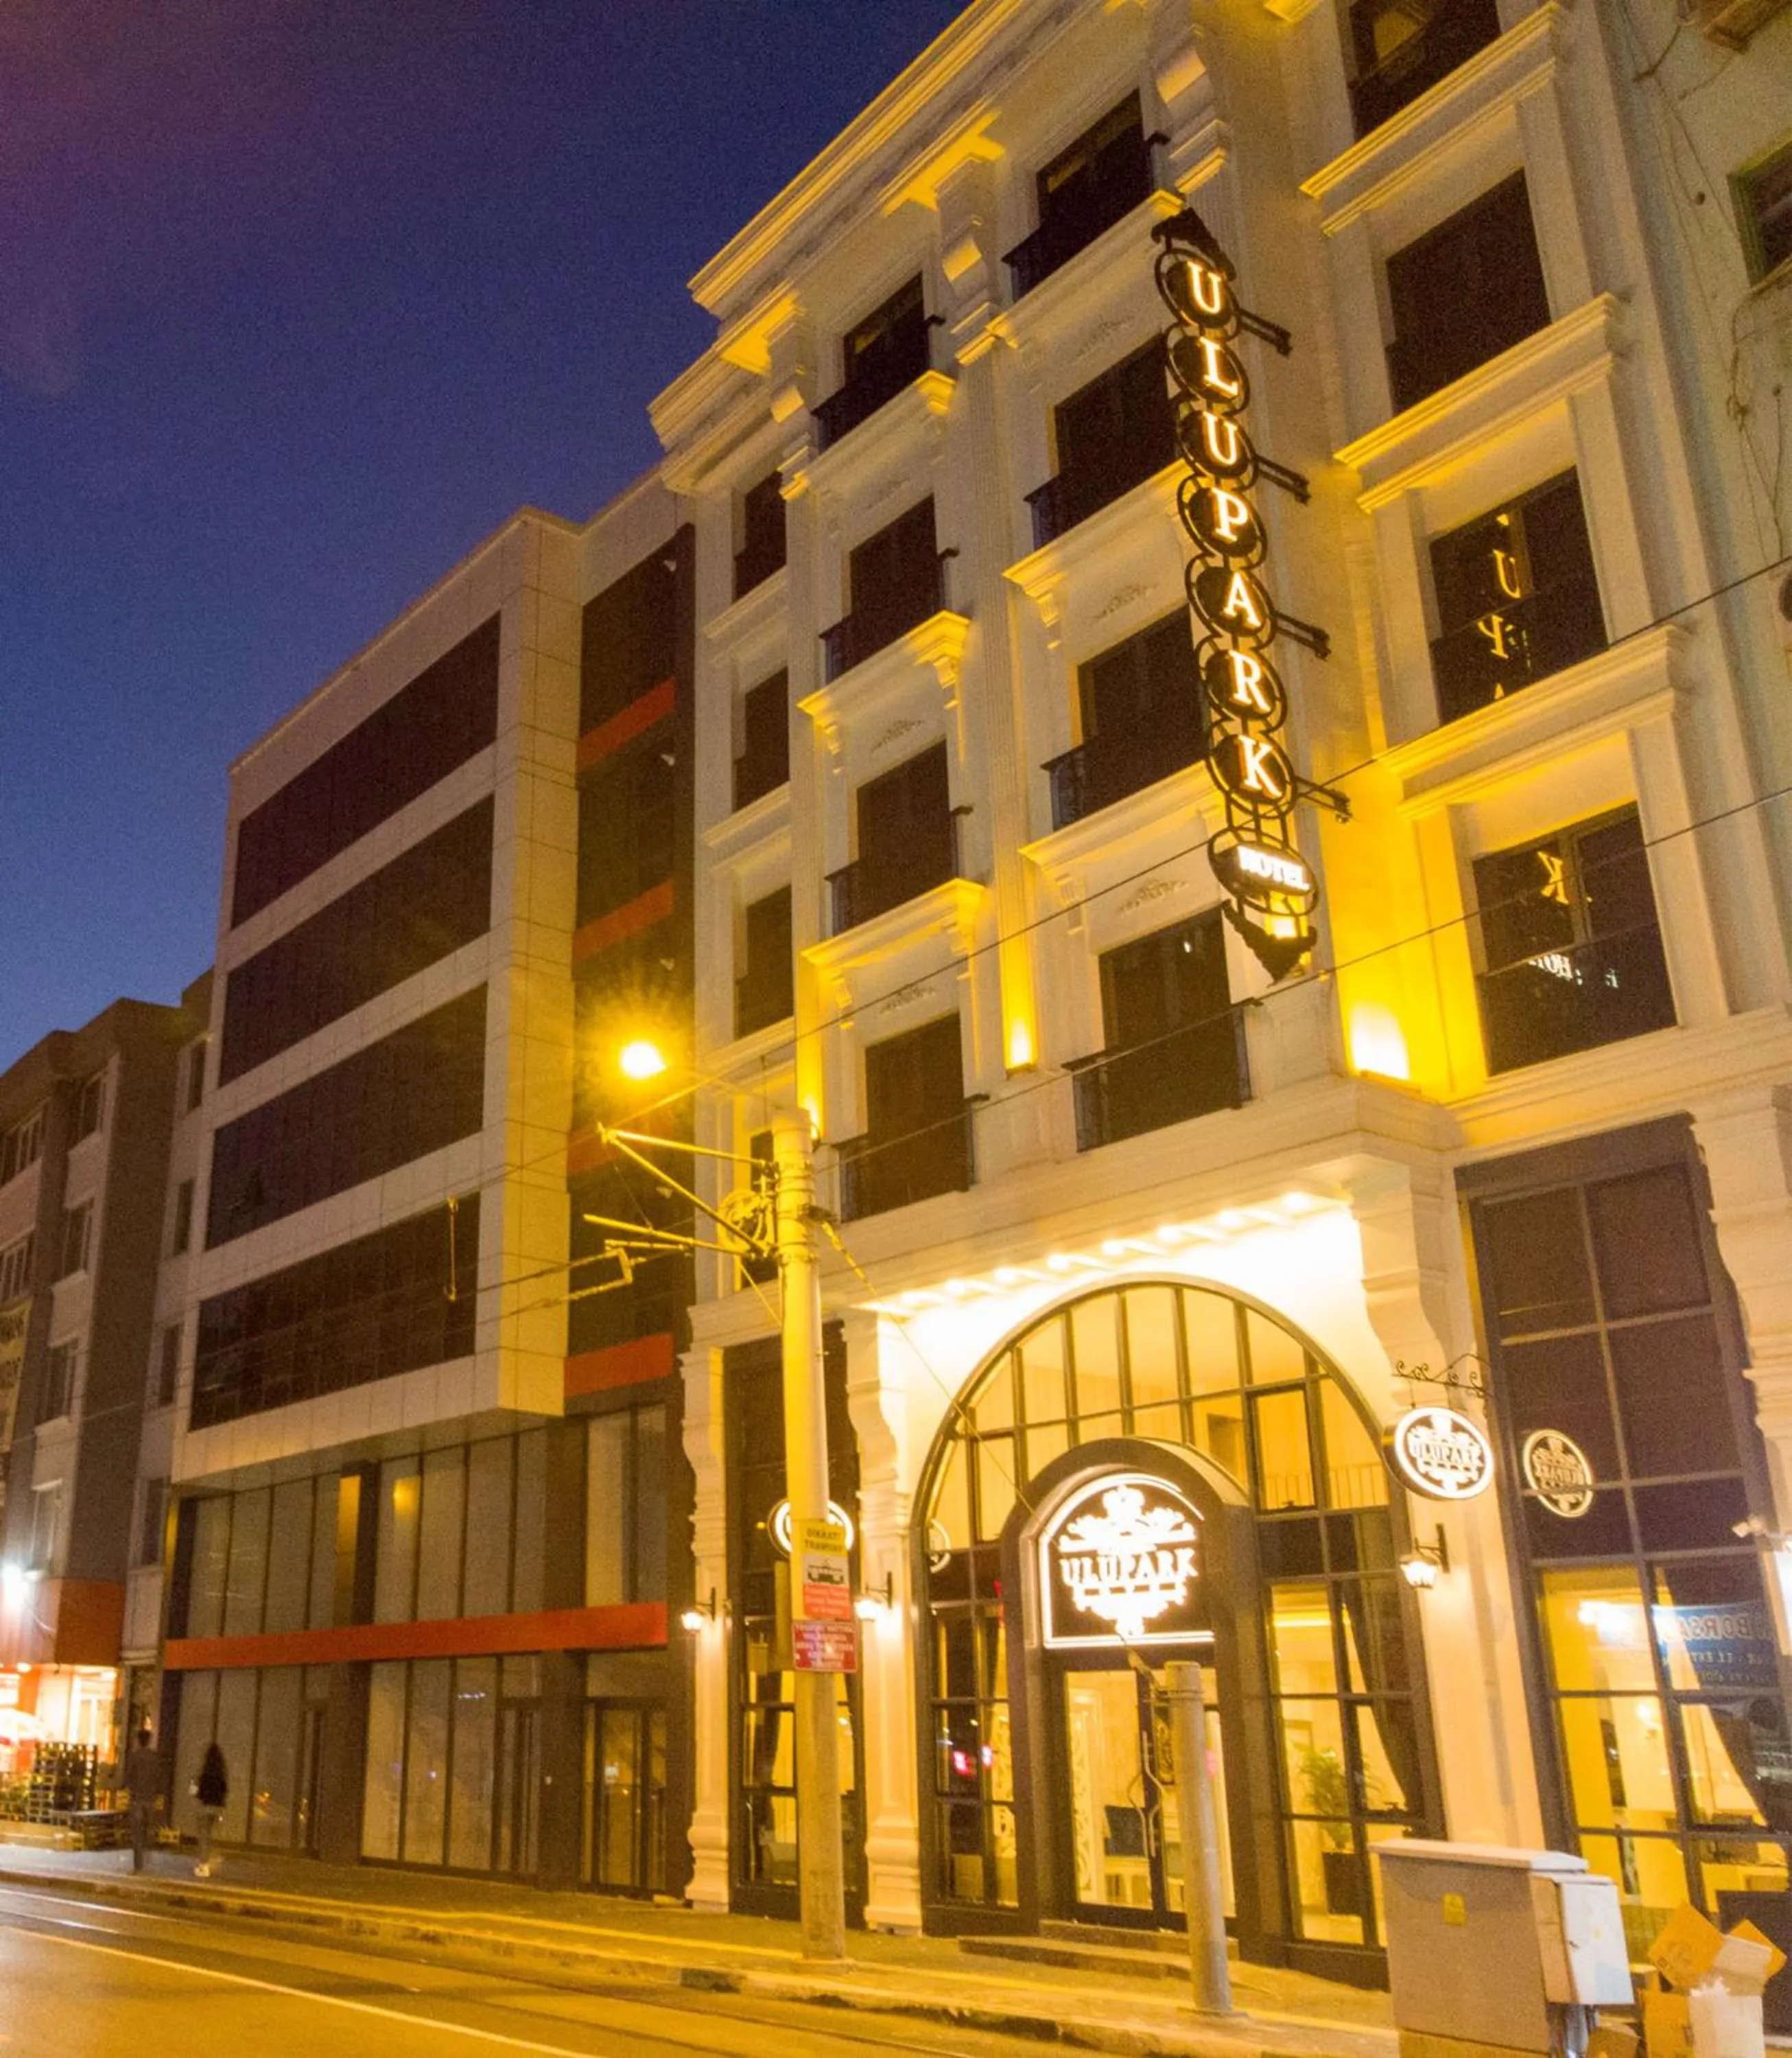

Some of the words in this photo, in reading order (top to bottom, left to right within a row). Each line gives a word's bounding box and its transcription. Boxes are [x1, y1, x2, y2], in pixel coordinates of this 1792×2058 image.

[1186, 260, 1284, 799] ULUPARK
[1237, 844, 1310, 890] HOTEL
[1060, 1548, 1197, 1586] ULUPARK
